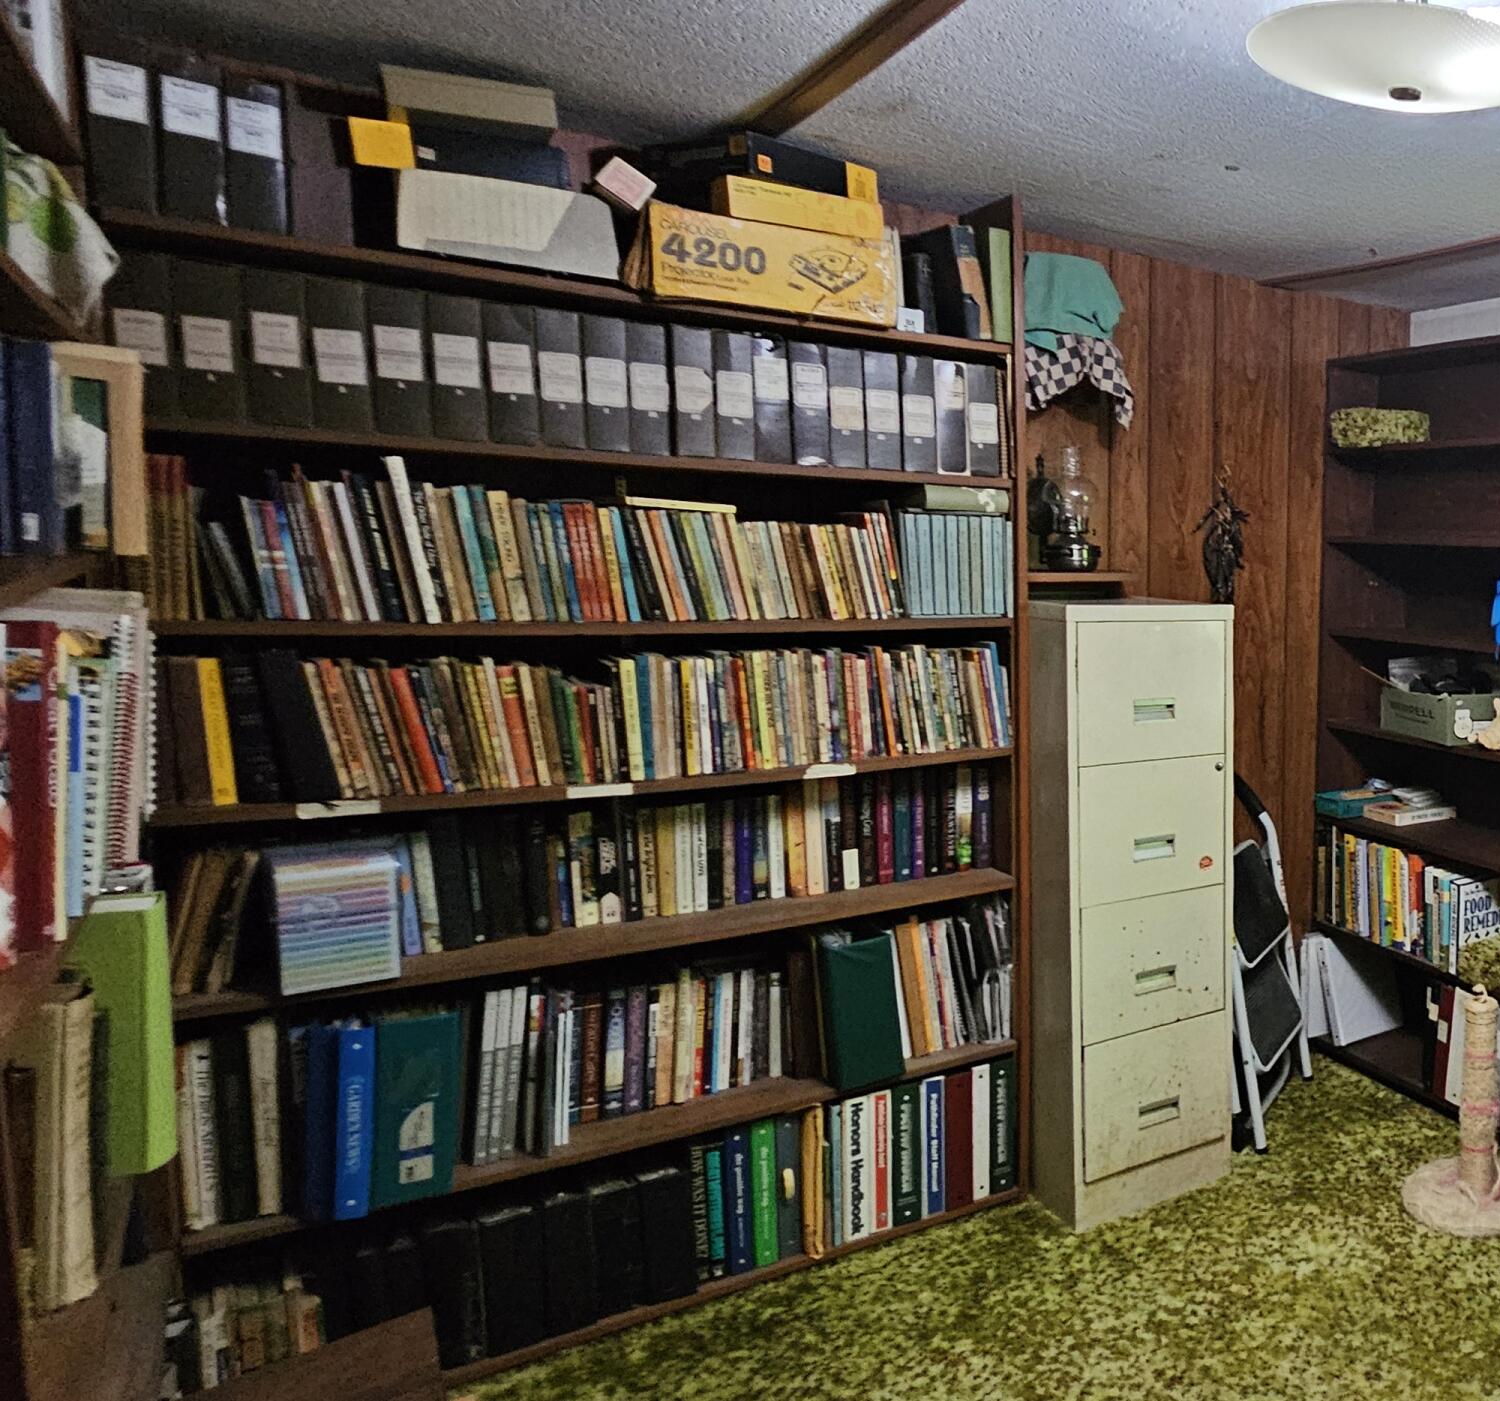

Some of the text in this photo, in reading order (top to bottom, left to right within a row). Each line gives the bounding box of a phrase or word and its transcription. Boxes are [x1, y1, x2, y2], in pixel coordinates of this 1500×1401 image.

[661, 232, 767, 275] 4200
[946, 810, 955, 834] NEWS
[947, 834, 955, 857] EVER
[1463, 895, 1492, 916] FOOD
[346, 1084, 361, 1168] GARDEN NEWS
[900, 1102, 913, 1193] PATHFINDER
[996, 1077, 1008, 1164] PATHFINDER
[689, 1146, 708, 1258] HOW WAS IT DONE?
[851, 1102, 864, 1235] Honors Handbook
